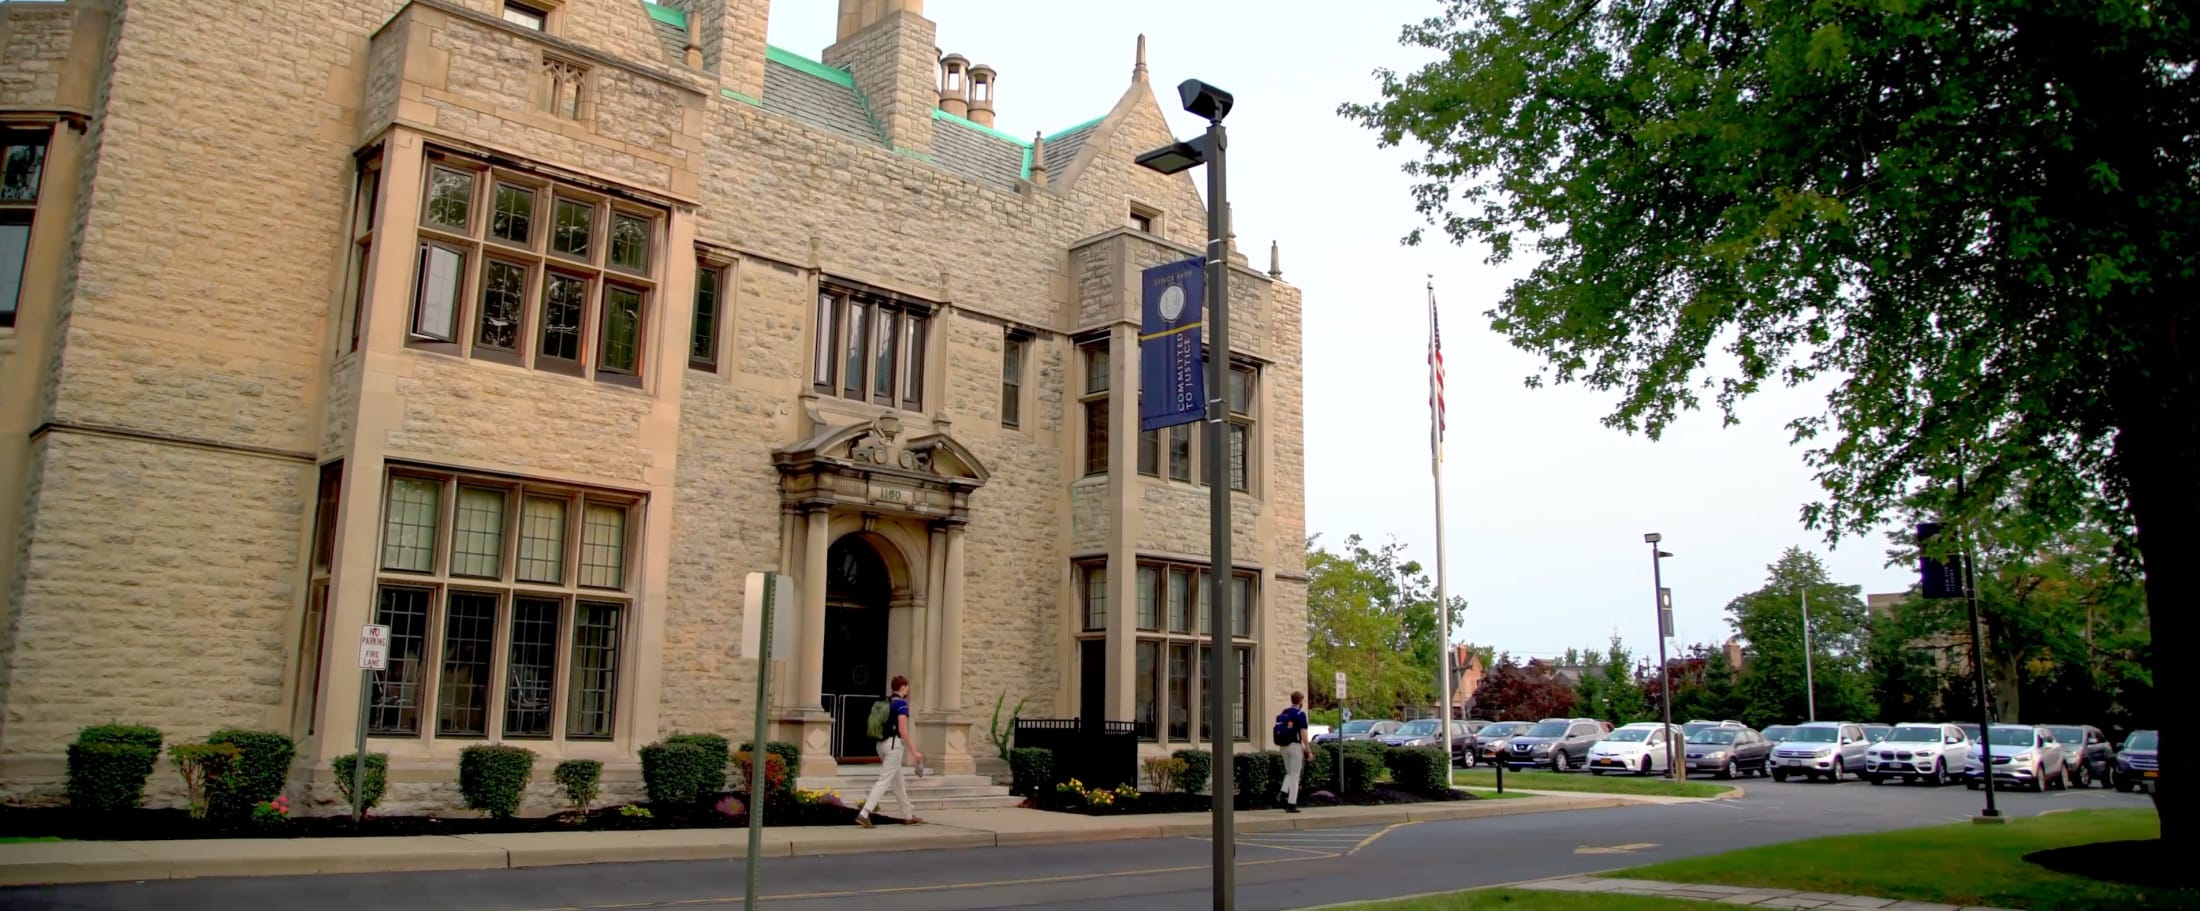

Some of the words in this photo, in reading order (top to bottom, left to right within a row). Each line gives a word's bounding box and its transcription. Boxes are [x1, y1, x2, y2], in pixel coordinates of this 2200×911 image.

[1184, 338, 1193, 387] JUSTICE
[1176, 333, 1185, 412] COMMITTED
[1185, 392, 1193, 410] TO
[370, 627, 380, 636] NO
[362, 637, 385, 647] PARKING
[366, 650, 380, 658] FIRE
